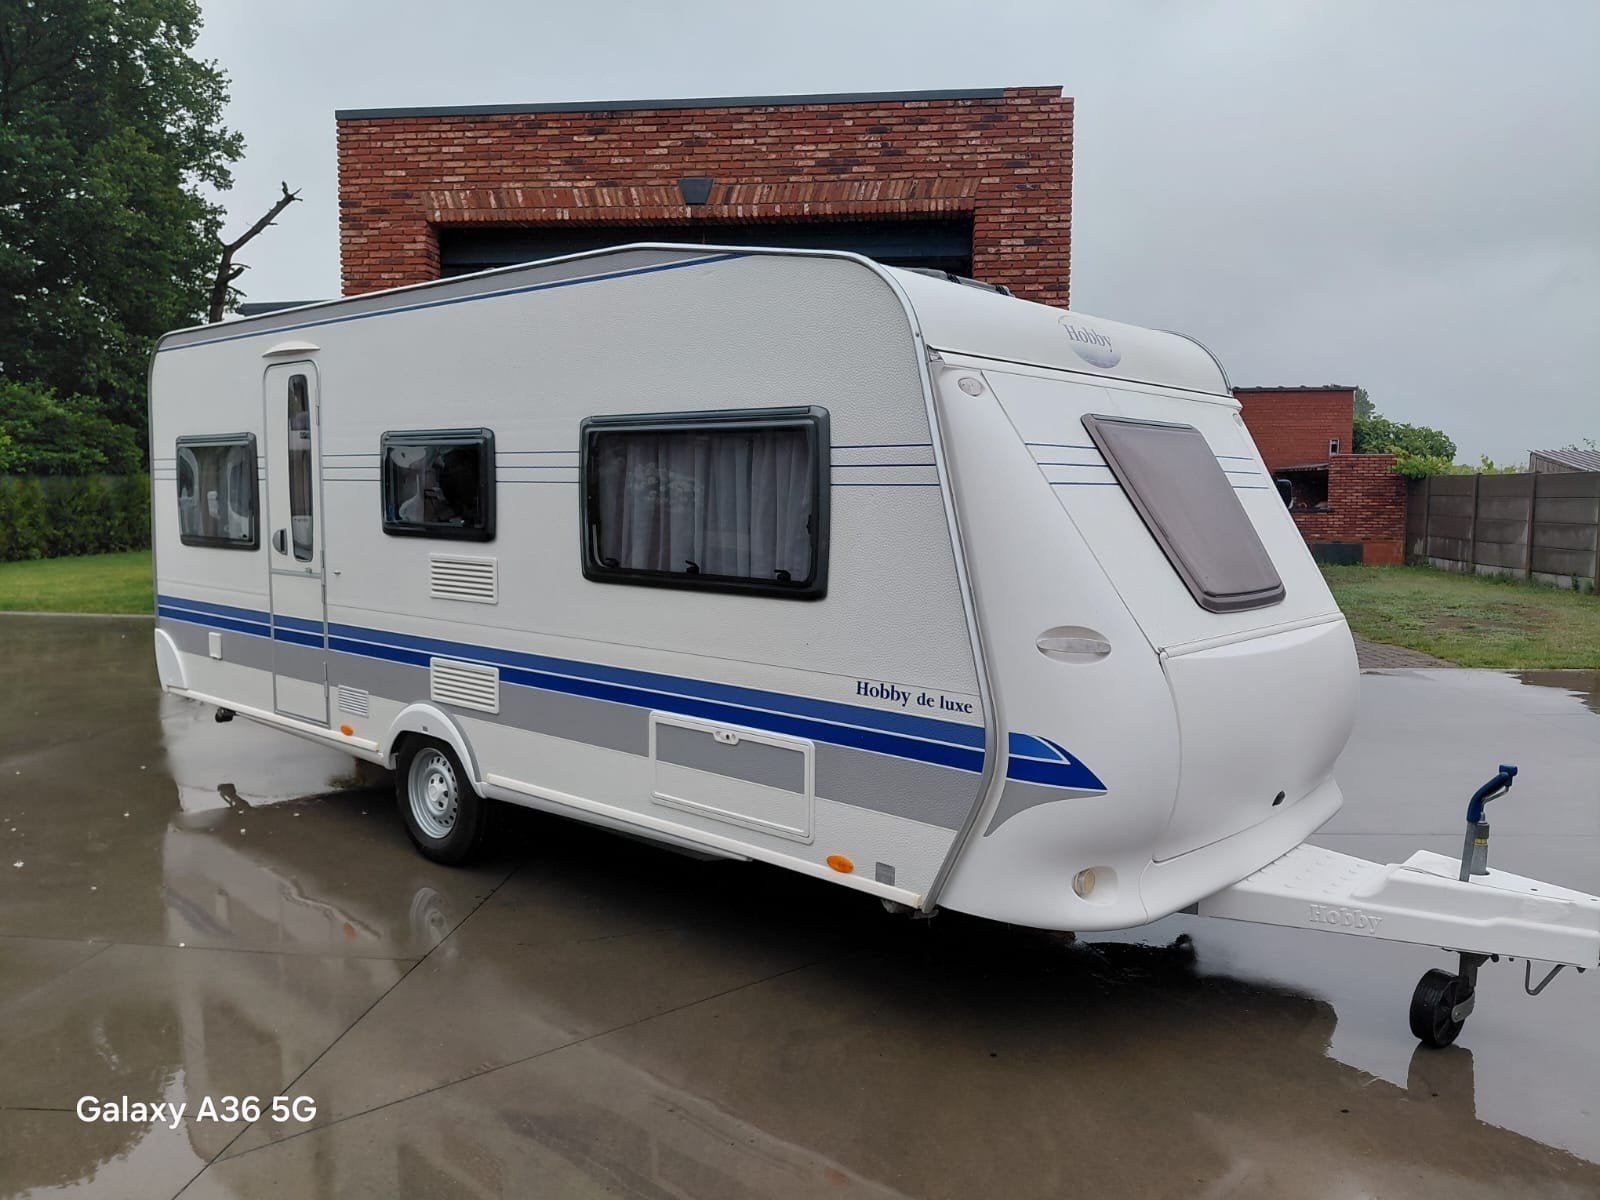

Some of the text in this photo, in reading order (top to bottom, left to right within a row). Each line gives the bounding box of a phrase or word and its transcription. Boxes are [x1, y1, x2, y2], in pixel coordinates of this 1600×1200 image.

[1063, 324, 1113, 353] Hobby
[856, 681, 973, 714] Hobby de luxe
[1309, 904, 1383, 935] Hobby
